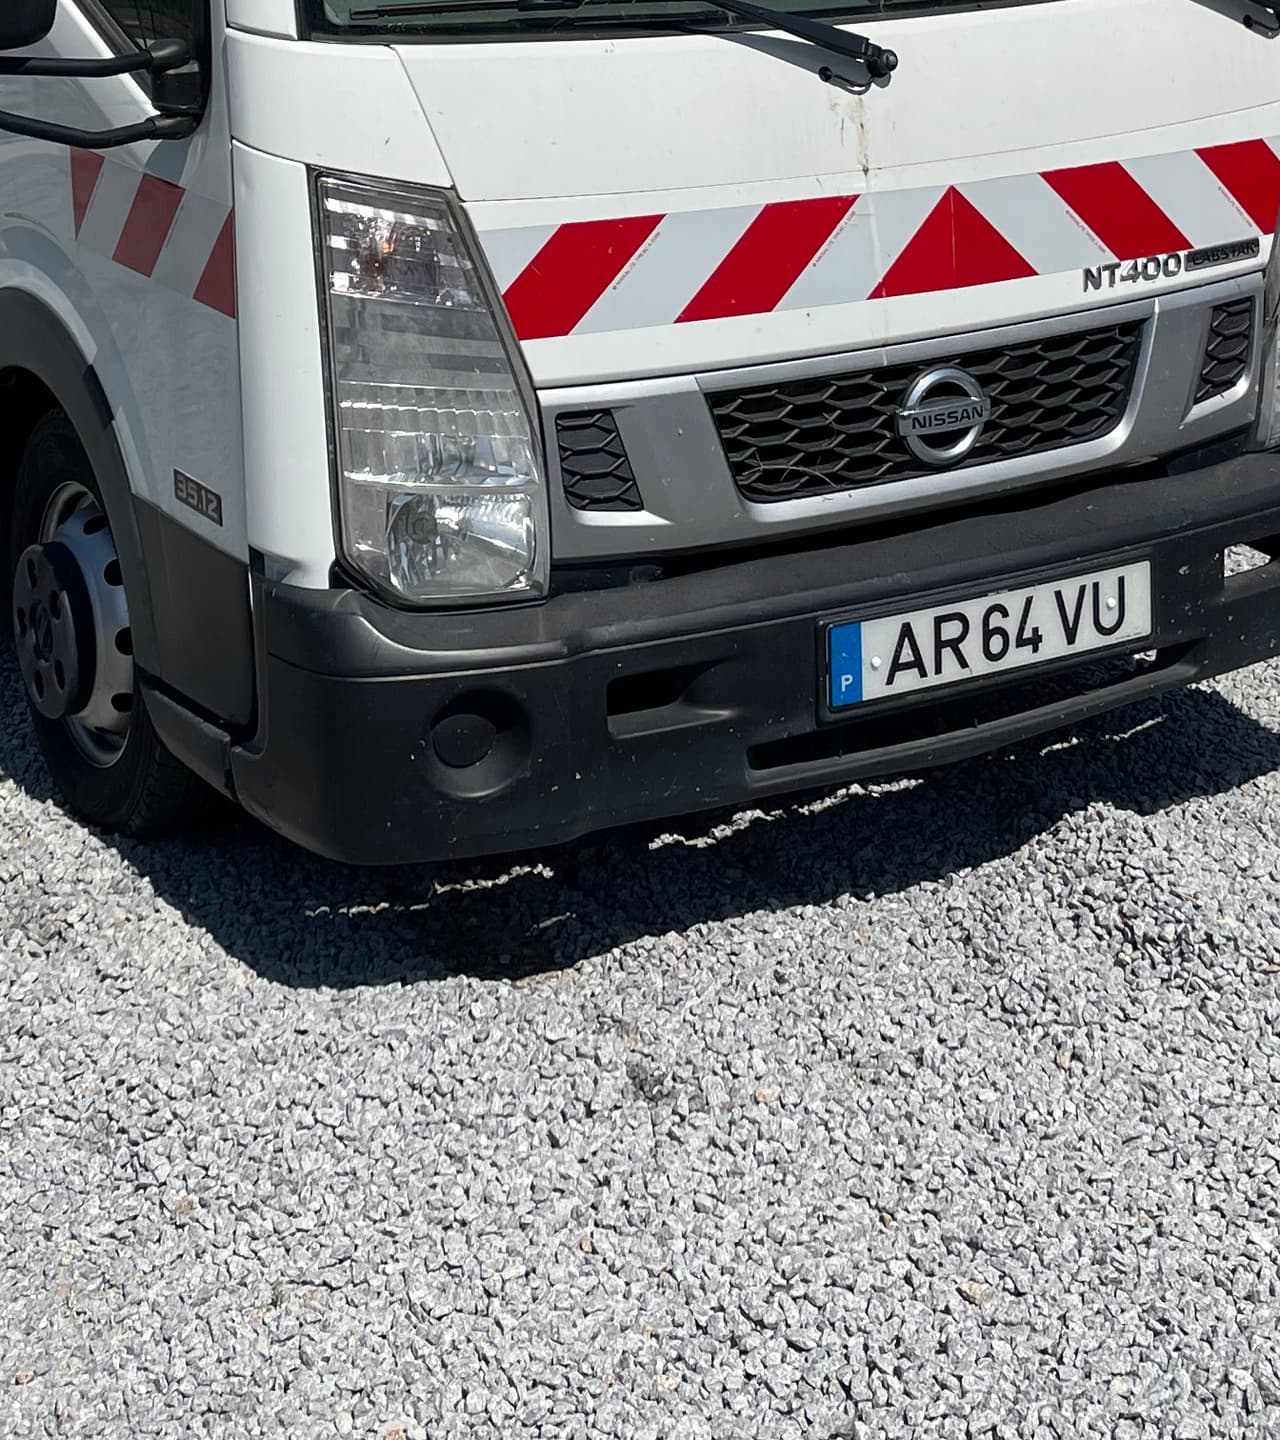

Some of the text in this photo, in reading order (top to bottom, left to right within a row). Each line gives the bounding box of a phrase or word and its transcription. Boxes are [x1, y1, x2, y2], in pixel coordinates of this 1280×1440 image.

[1083, 252, 1182, 293] NT400
[911, 405, 984, 430] NISSAN
[176, 472, 219, 520] 35.12
[840, 673, 853, 693] P
